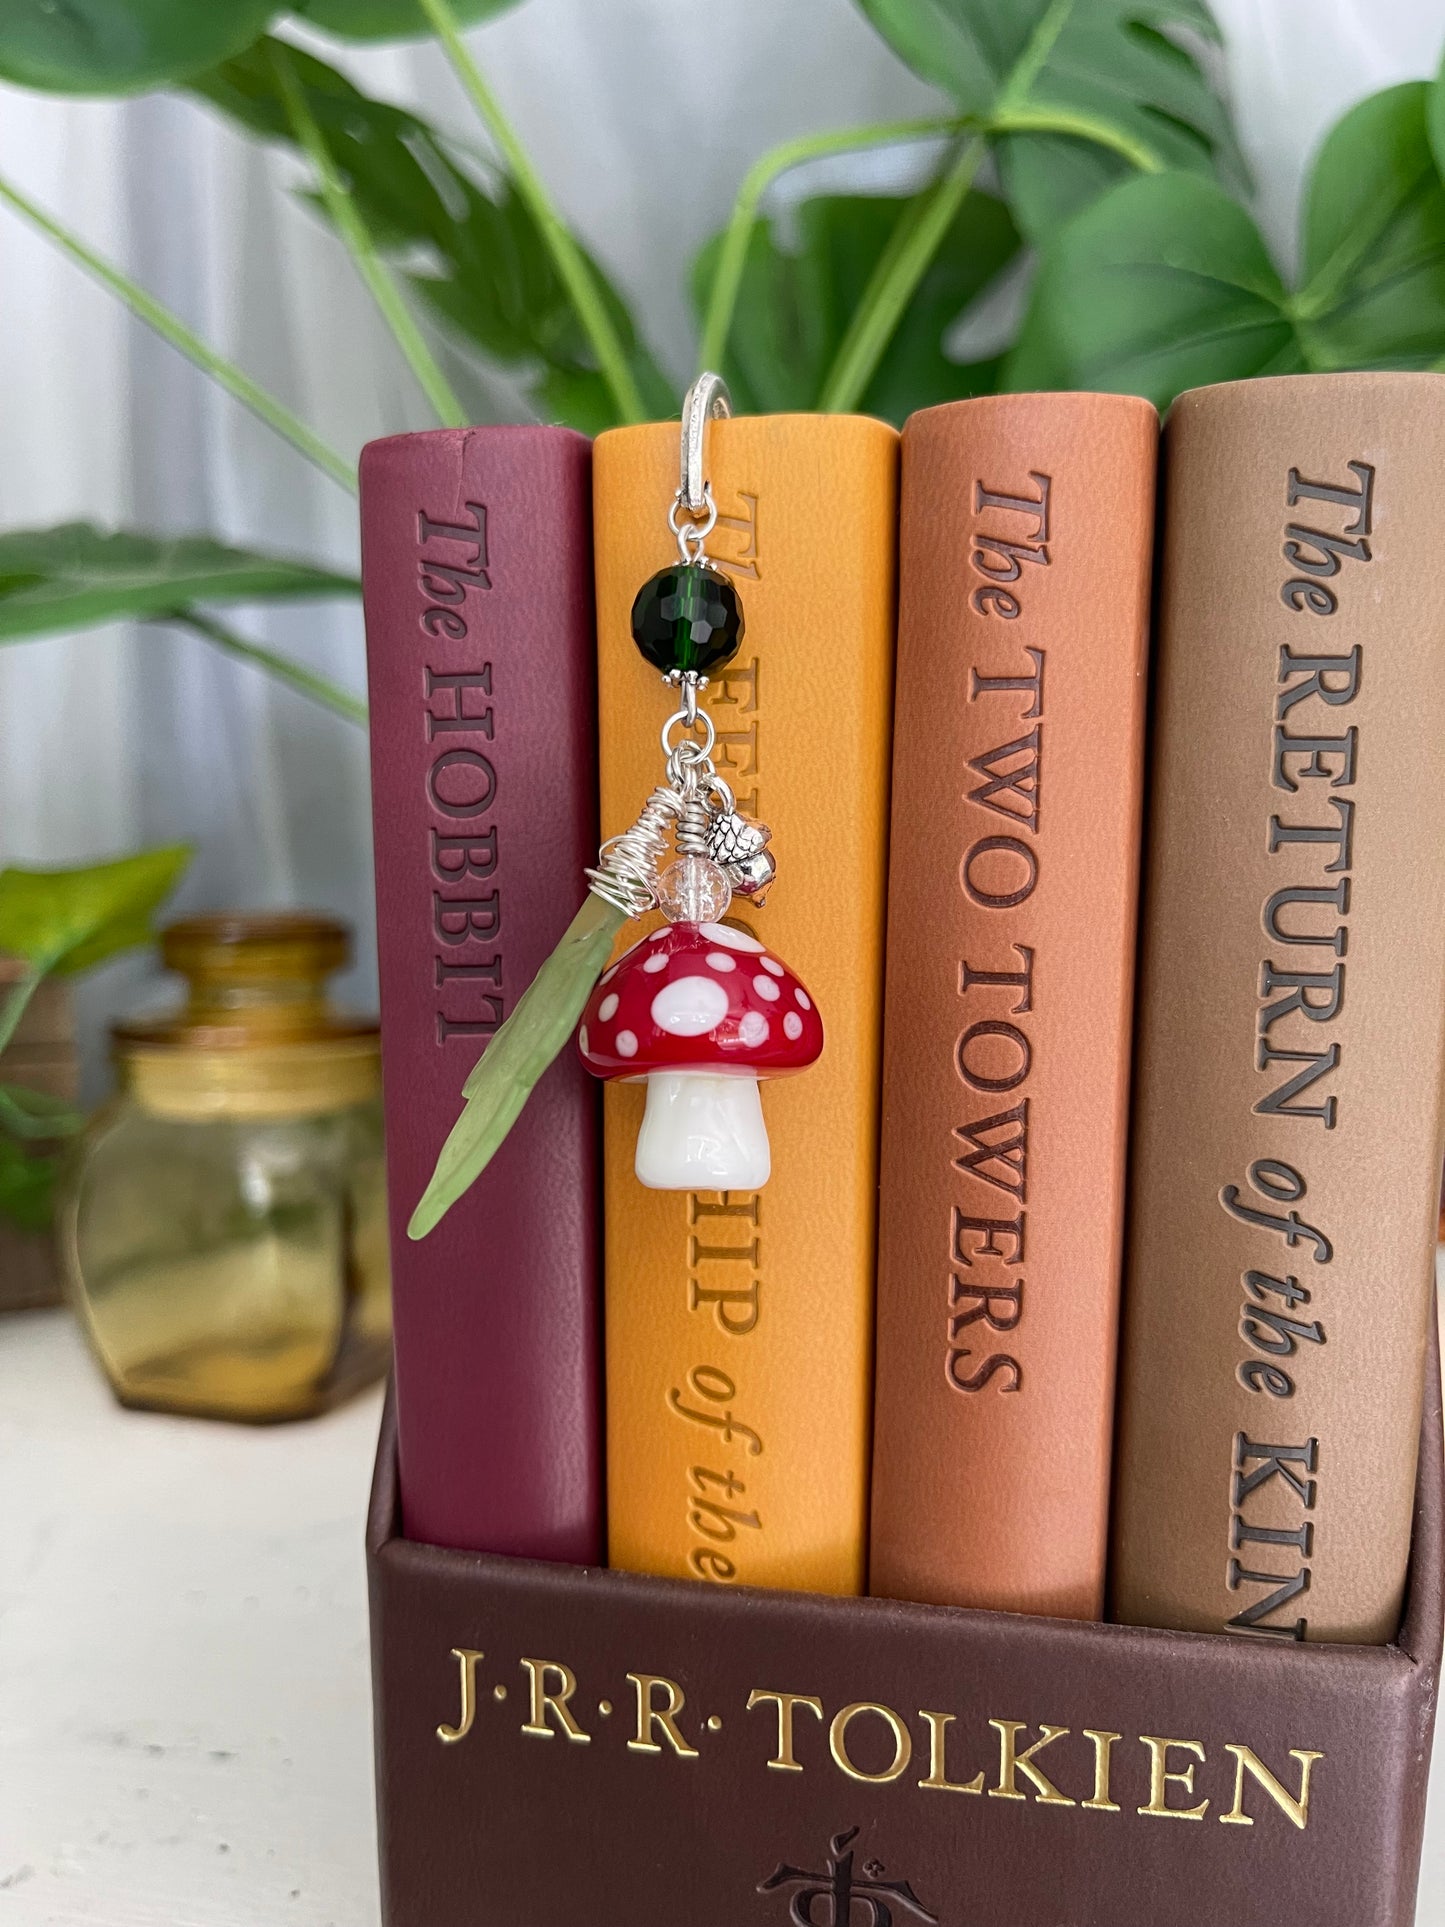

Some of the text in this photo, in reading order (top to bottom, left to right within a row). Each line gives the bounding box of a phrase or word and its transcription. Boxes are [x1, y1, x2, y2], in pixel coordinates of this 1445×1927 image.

[418, 500, 504, 1046] The HOBBIT
[946, 470, 1052, 1395] The TWO TOWERS
[1219, 460, 1376, 1643] The RETURN of the KIN
[667, 1364, 762, 1457] of
[687, 1464, 762, 1583] the
[746, 1688, 1325, 1830] TOLKIEN
